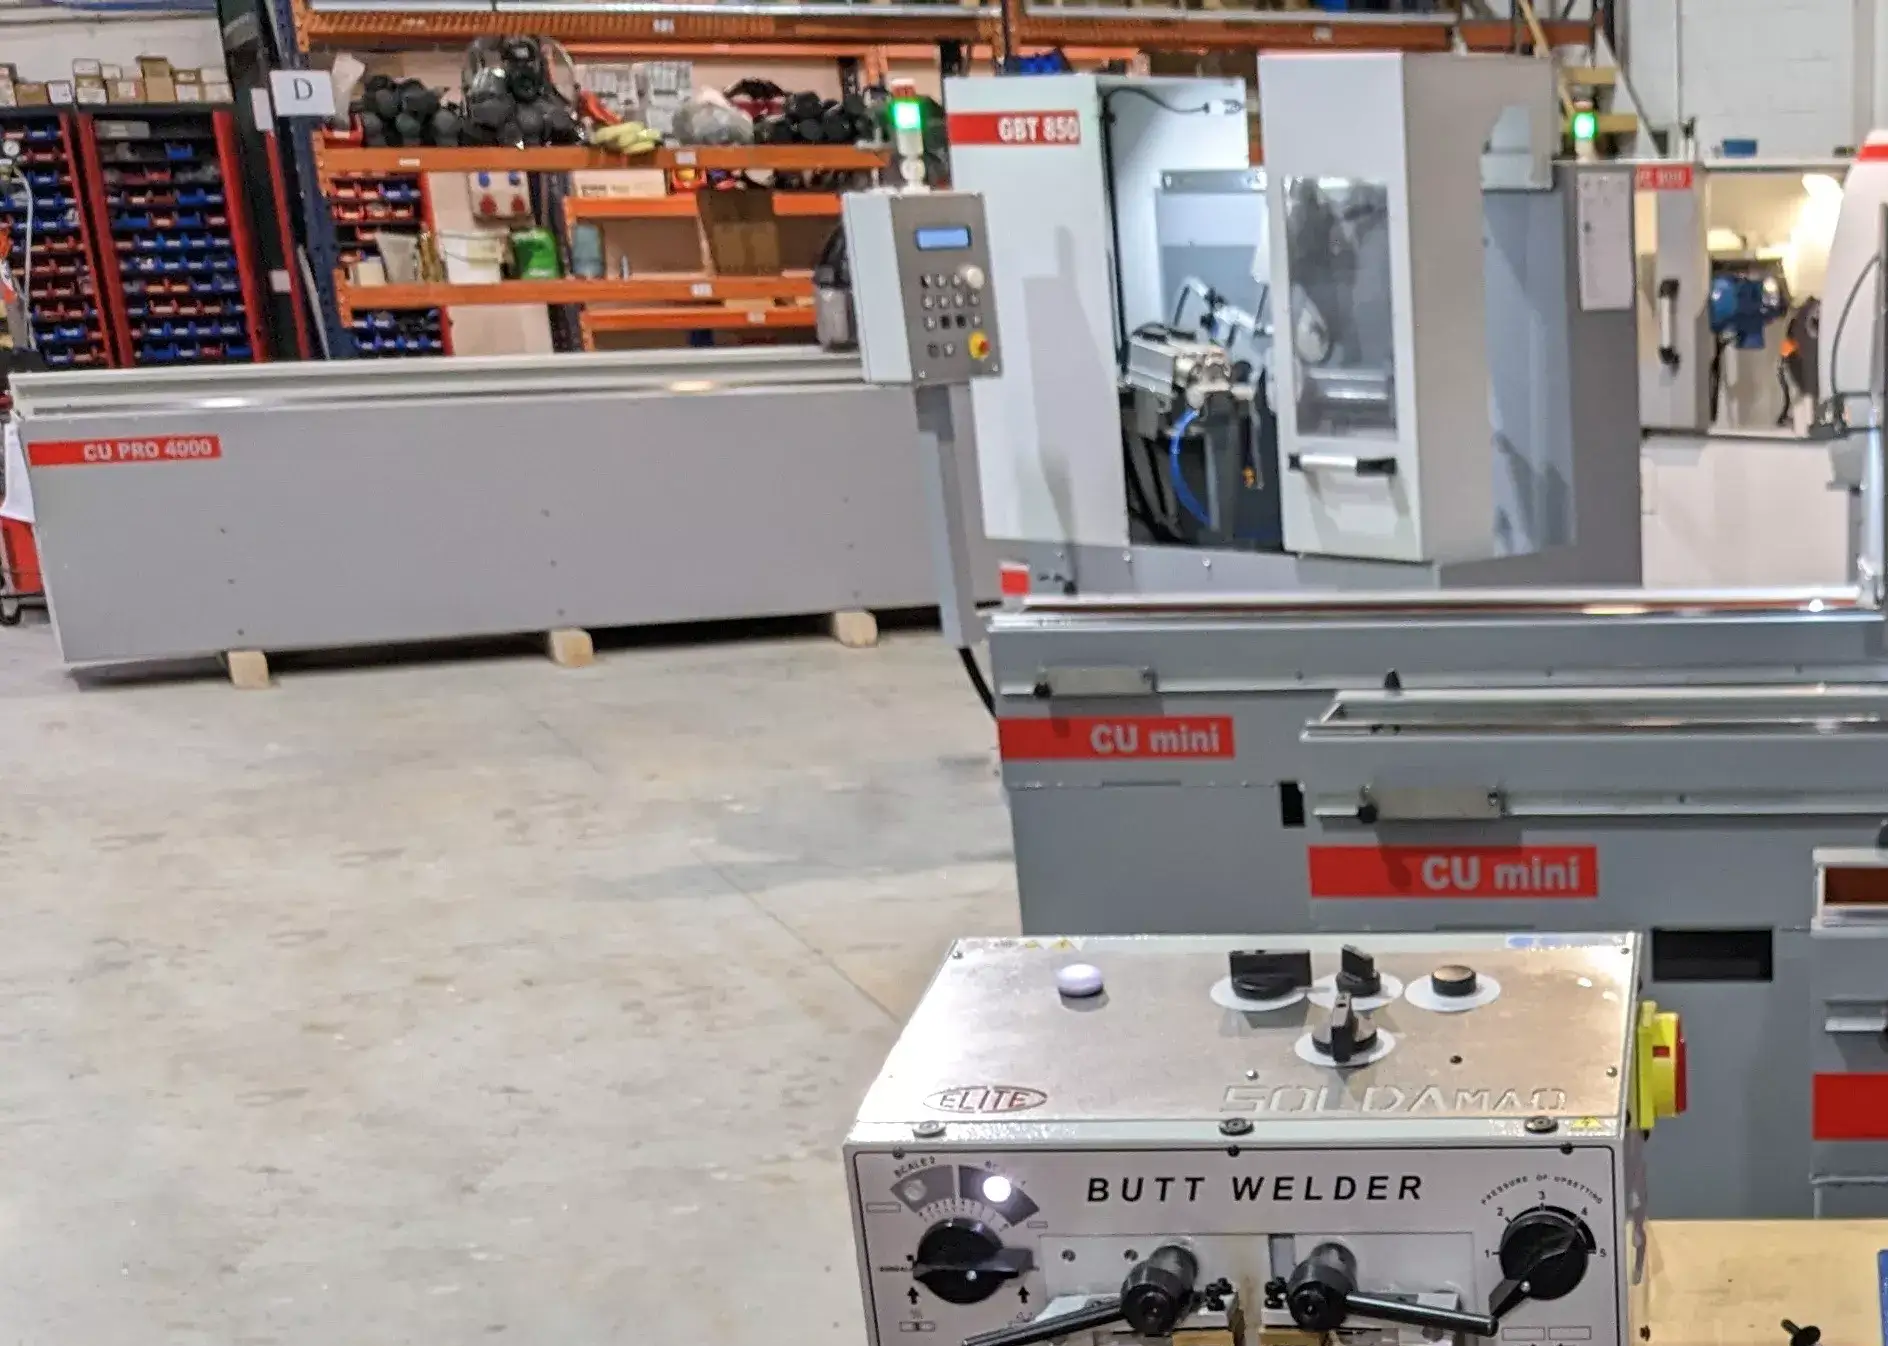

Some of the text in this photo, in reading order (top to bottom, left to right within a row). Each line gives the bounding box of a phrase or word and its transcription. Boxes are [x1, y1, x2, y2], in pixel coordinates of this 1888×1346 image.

[292, 77, 314, 101] D
[998, 115, 1080, 142] GBT 850
[83, 439, 212, 461] CU PRO 4000
[1090, 722, 1221, 754] CU mini
[1421, 854, 1580, 891] CU mini
[939, 1089, 1032, 1111] ELITE
[1086, 1174, 1424, 1203] BUTT WELDER
[1537, 1190, 1546, 1201] 3
[1496, 1206, 1504, 1217] 2
[1580, 1206, 1588, 1216] 4
[1599, 1247, 1607, 1258] 5
